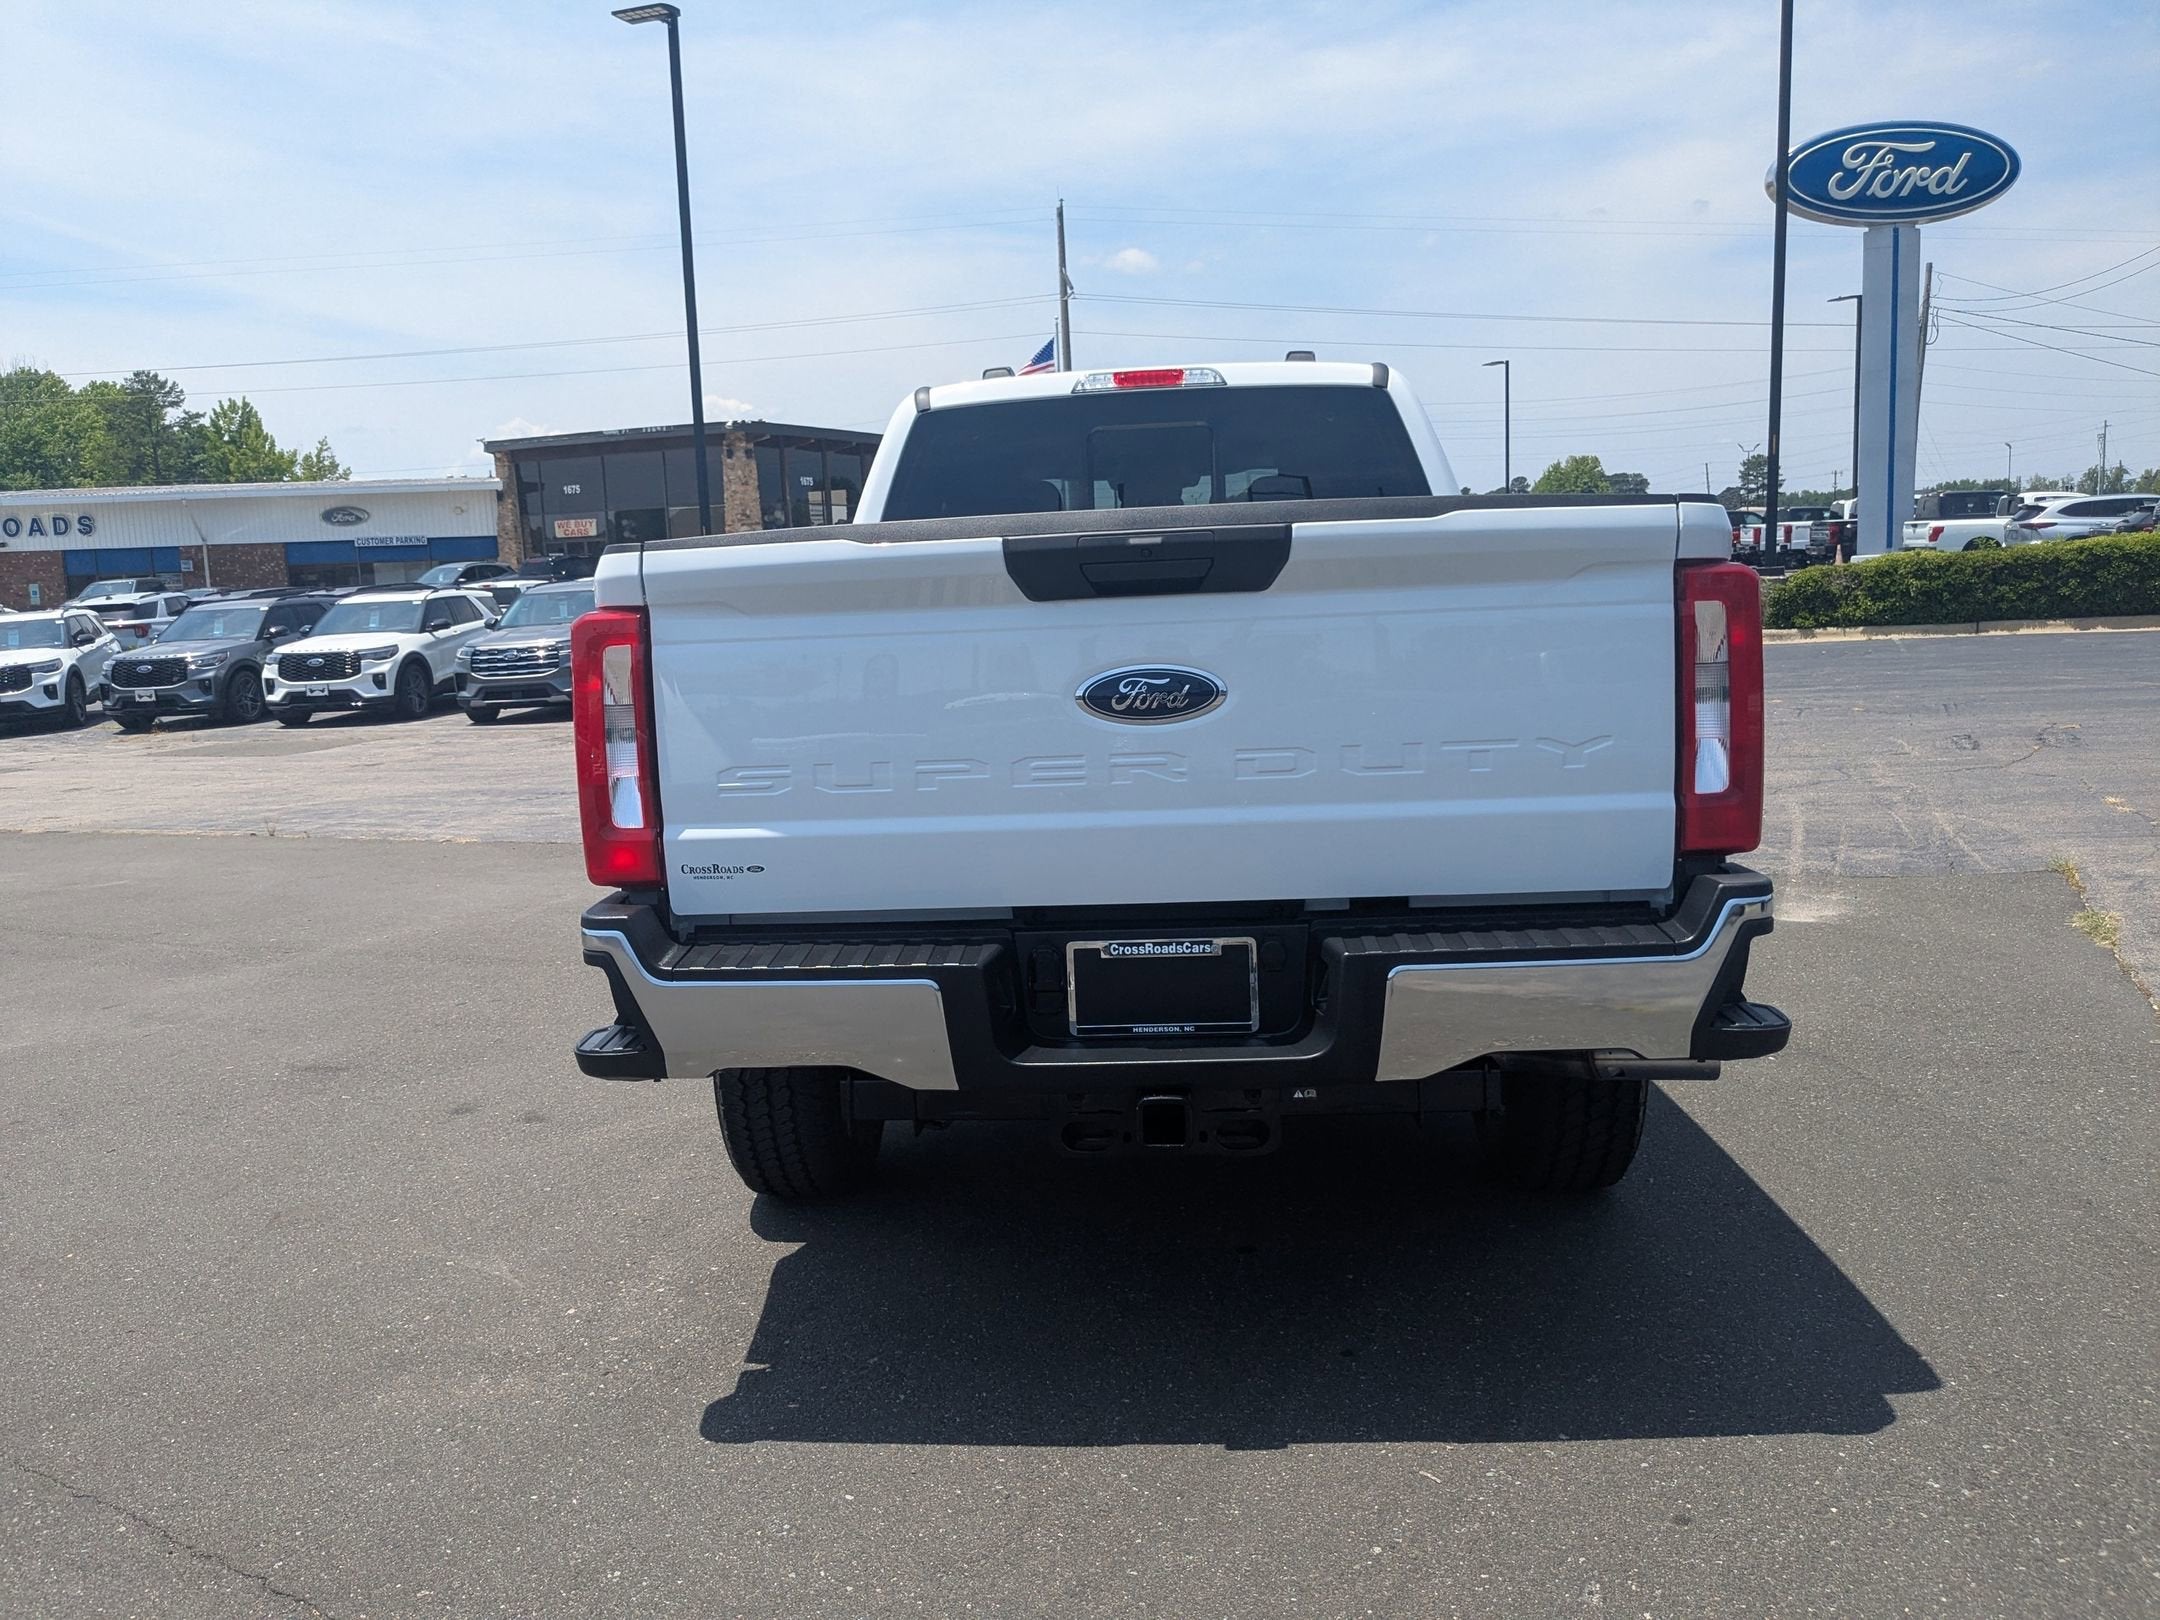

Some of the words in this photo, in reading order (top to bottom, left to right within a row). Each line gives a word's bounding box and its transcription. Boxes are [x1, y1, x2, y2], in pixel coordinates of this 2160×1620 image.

[1828, 141, 1972, 200] Ford
[800, 476, 814, 486] 1675
[563, 485, 581, 495] 1675
[2, 515, 96, 538] OADS
[556, 521, 572, 529] WE
[574, 520, 593, 528] BUY
[563, 527, 589, 537] CARS
[356, 536, 394, 546] CUSTOMER
[395, 535, 427, 545] PARKING
[1111, 677, 1190, 711] Ford
[717, 751, 1188, 797] SUPER
[1235, 735, 1614, 781] DUTY
[1110, 942, 1211, 956] CrossRoadsCars
